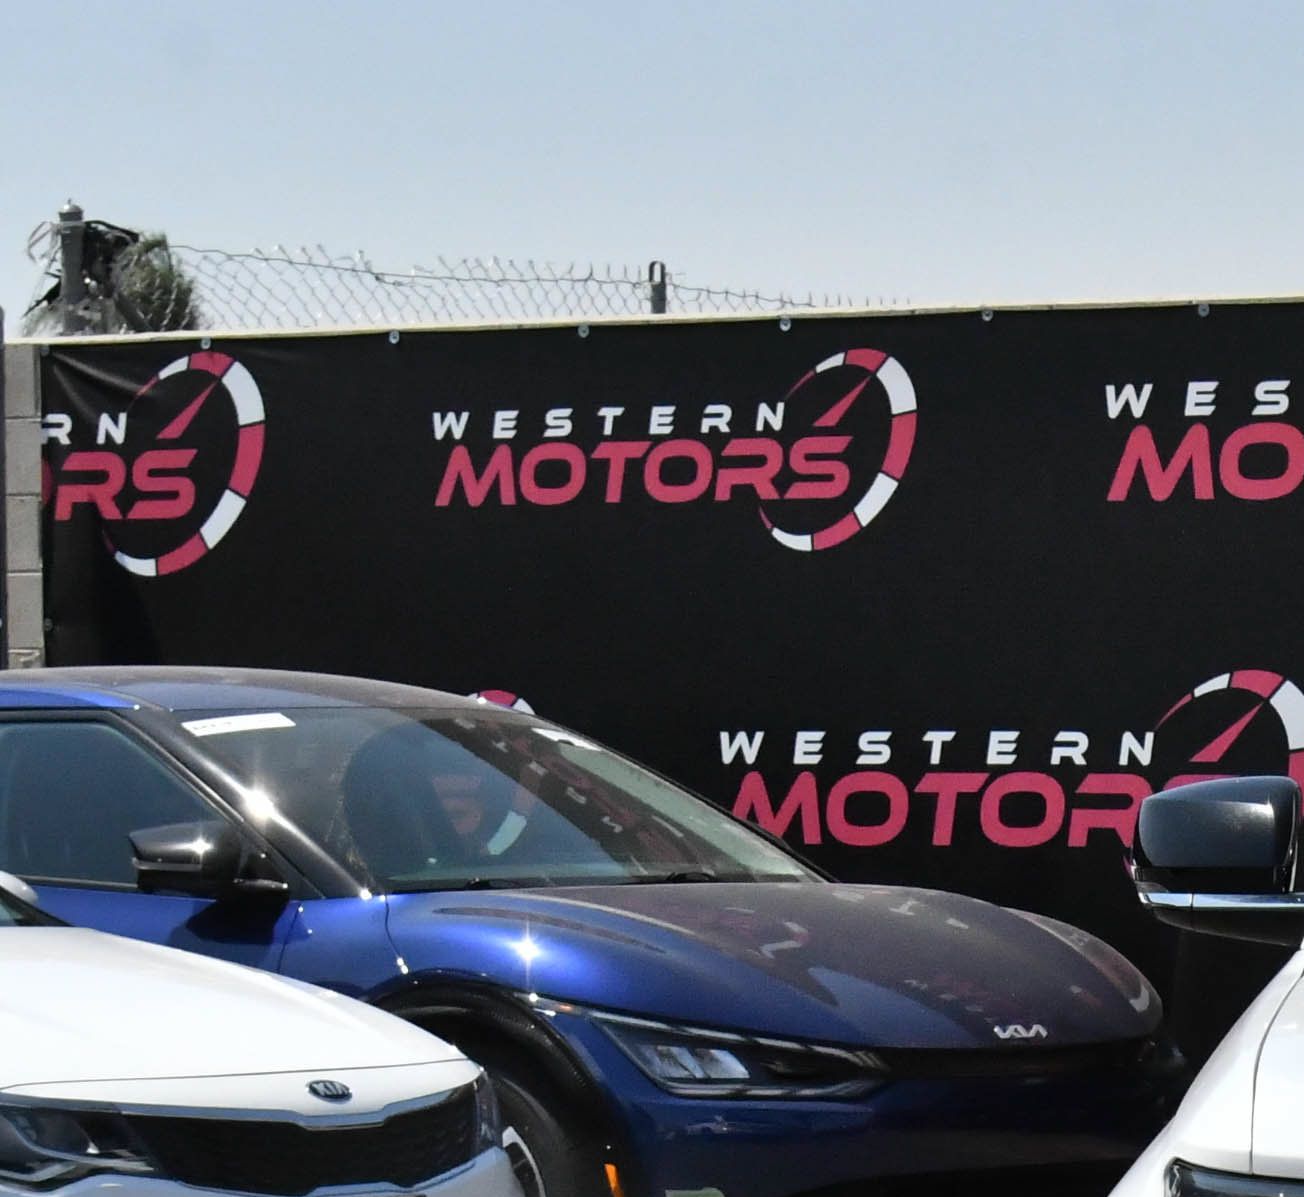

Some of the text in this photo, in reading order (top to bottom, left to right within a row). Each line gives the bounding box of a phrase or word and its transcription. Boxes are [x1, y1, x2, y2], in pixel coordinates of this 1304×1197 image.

[433, 402, 785, 440] WESTERN
[41, 448, 198, 521] RS
[435, 434, 853, 507] MOTORS
[720, 731, 1154, 766] WESTERN
[731, 770, 1228, 848] MOTOR
[993, 1023, 1048, 1039] KIA
